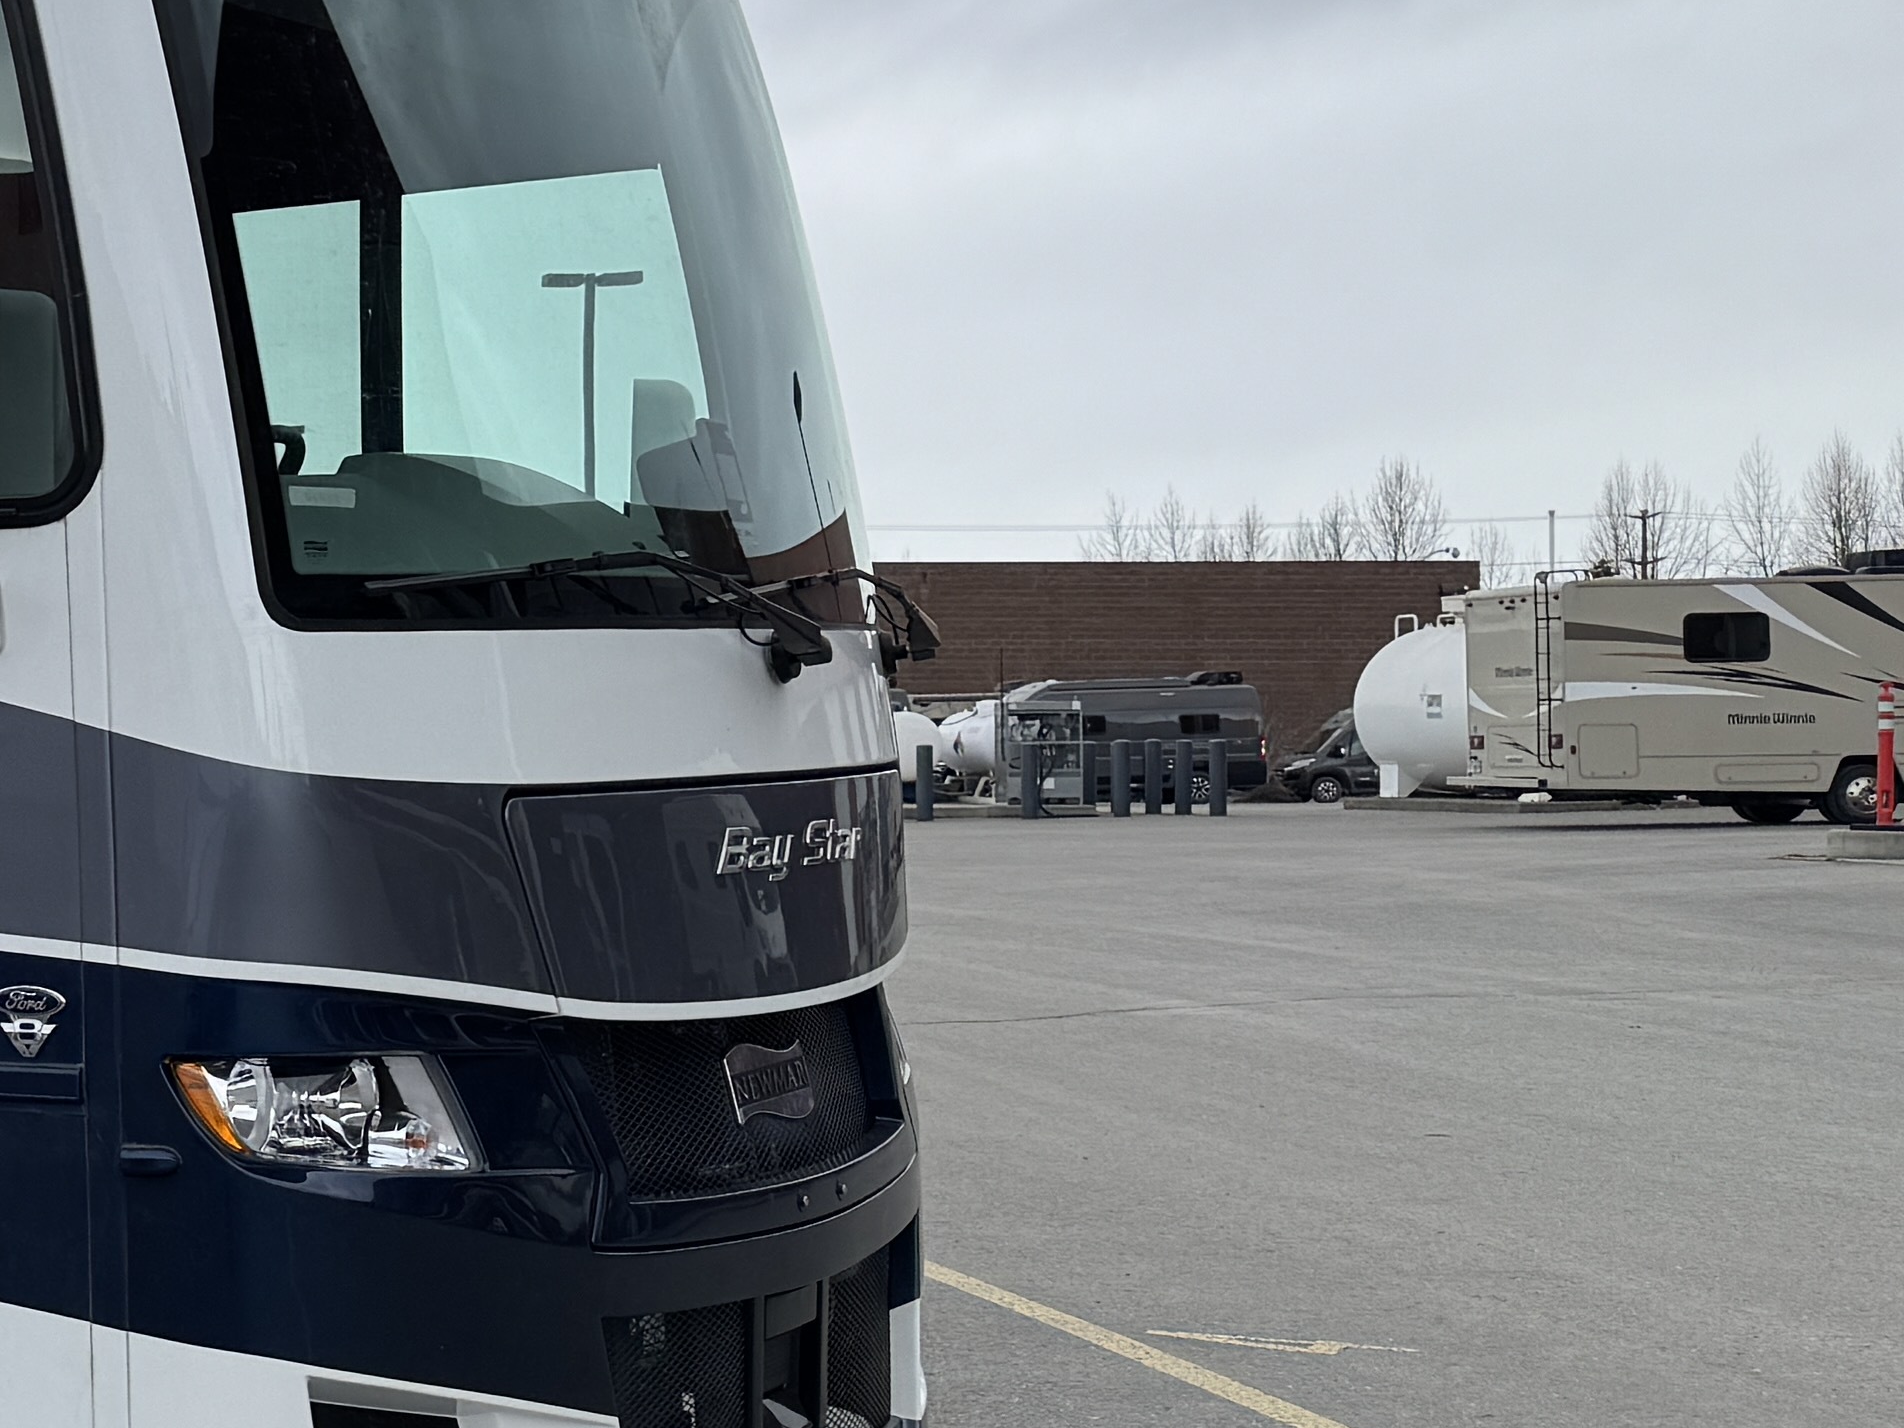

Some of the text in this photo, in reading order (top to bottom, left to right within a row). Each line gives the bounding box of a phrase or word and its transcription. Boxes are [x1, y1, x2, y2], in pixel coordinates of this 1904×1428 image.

[1727, 712, 1816, 725] Minnie Winnie
[716, 818, 862, 882] Bay Star
[5, 990, 47, 1010] Ford
